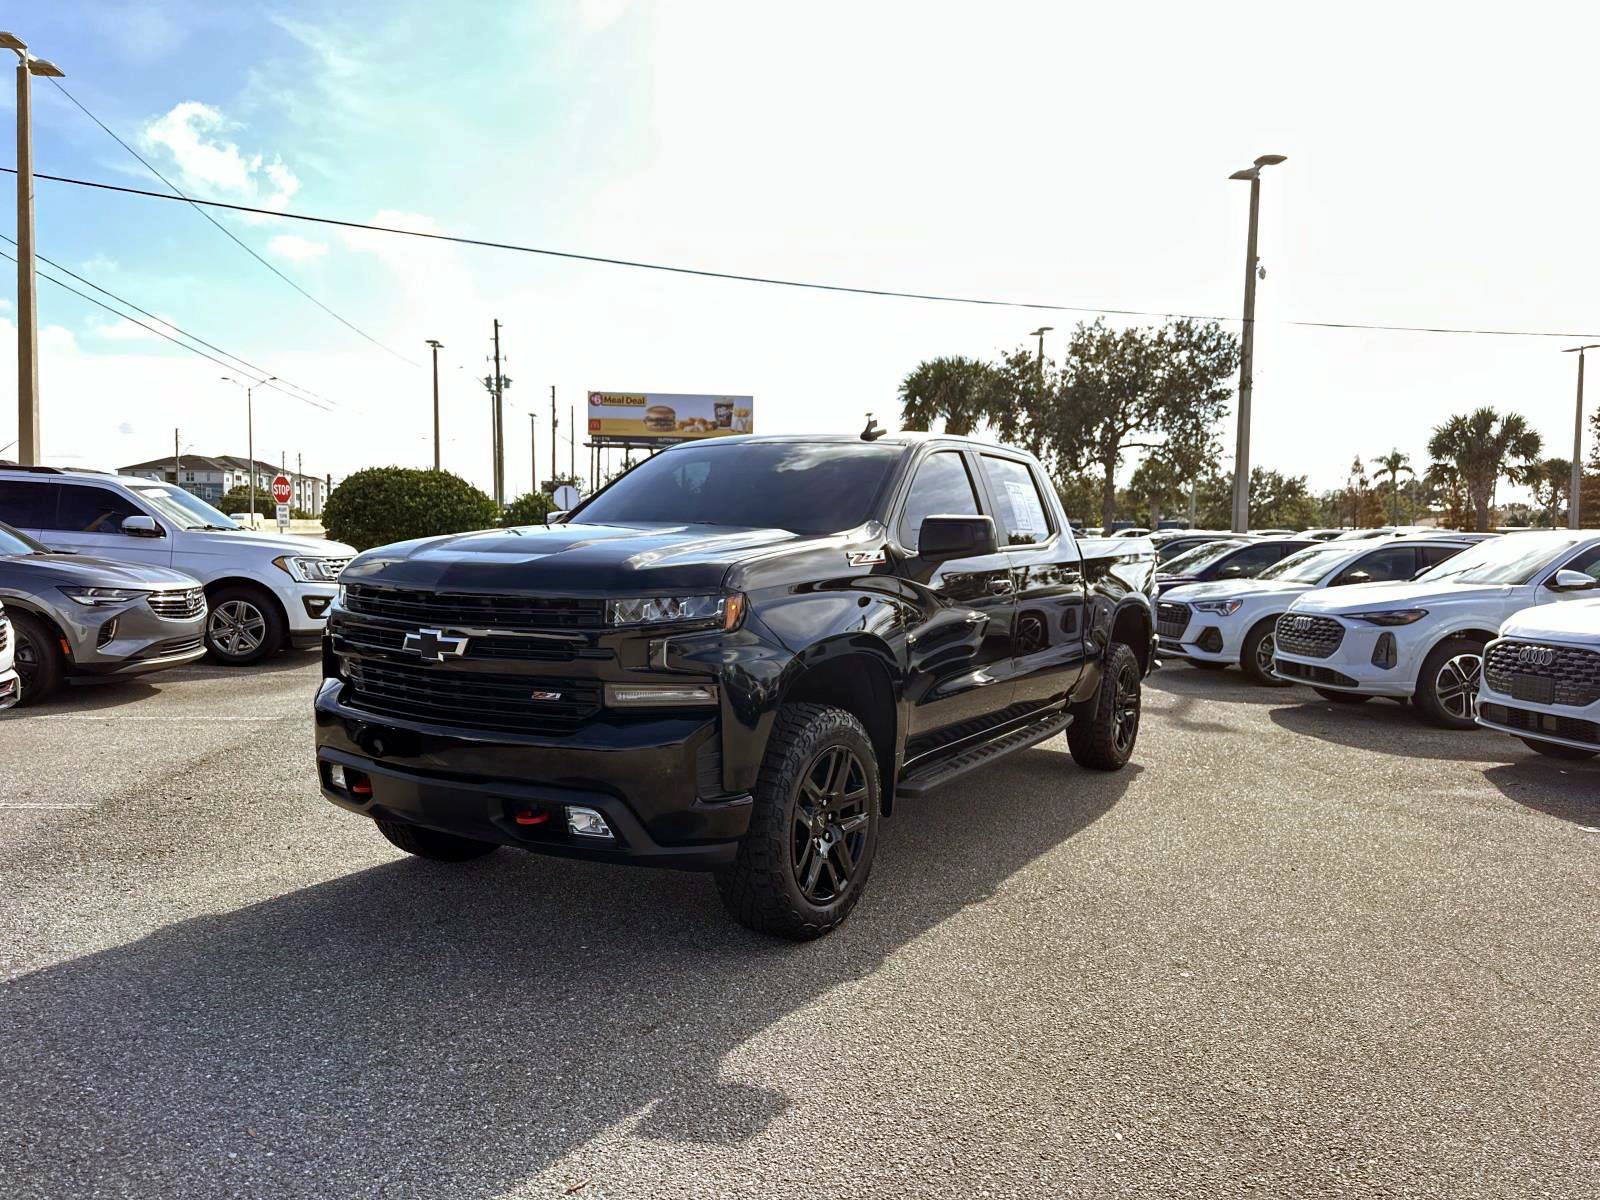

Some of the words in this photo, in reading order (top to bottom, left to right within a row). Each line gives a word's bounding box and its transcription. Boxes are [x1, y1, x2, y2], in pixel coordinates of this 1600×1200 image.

[604, 396, 624, 404] Meal
[626, 397, 645, 405] Deal
[274, 484, 290, 495] STOP
[531, 691, 562, 701] Z71
